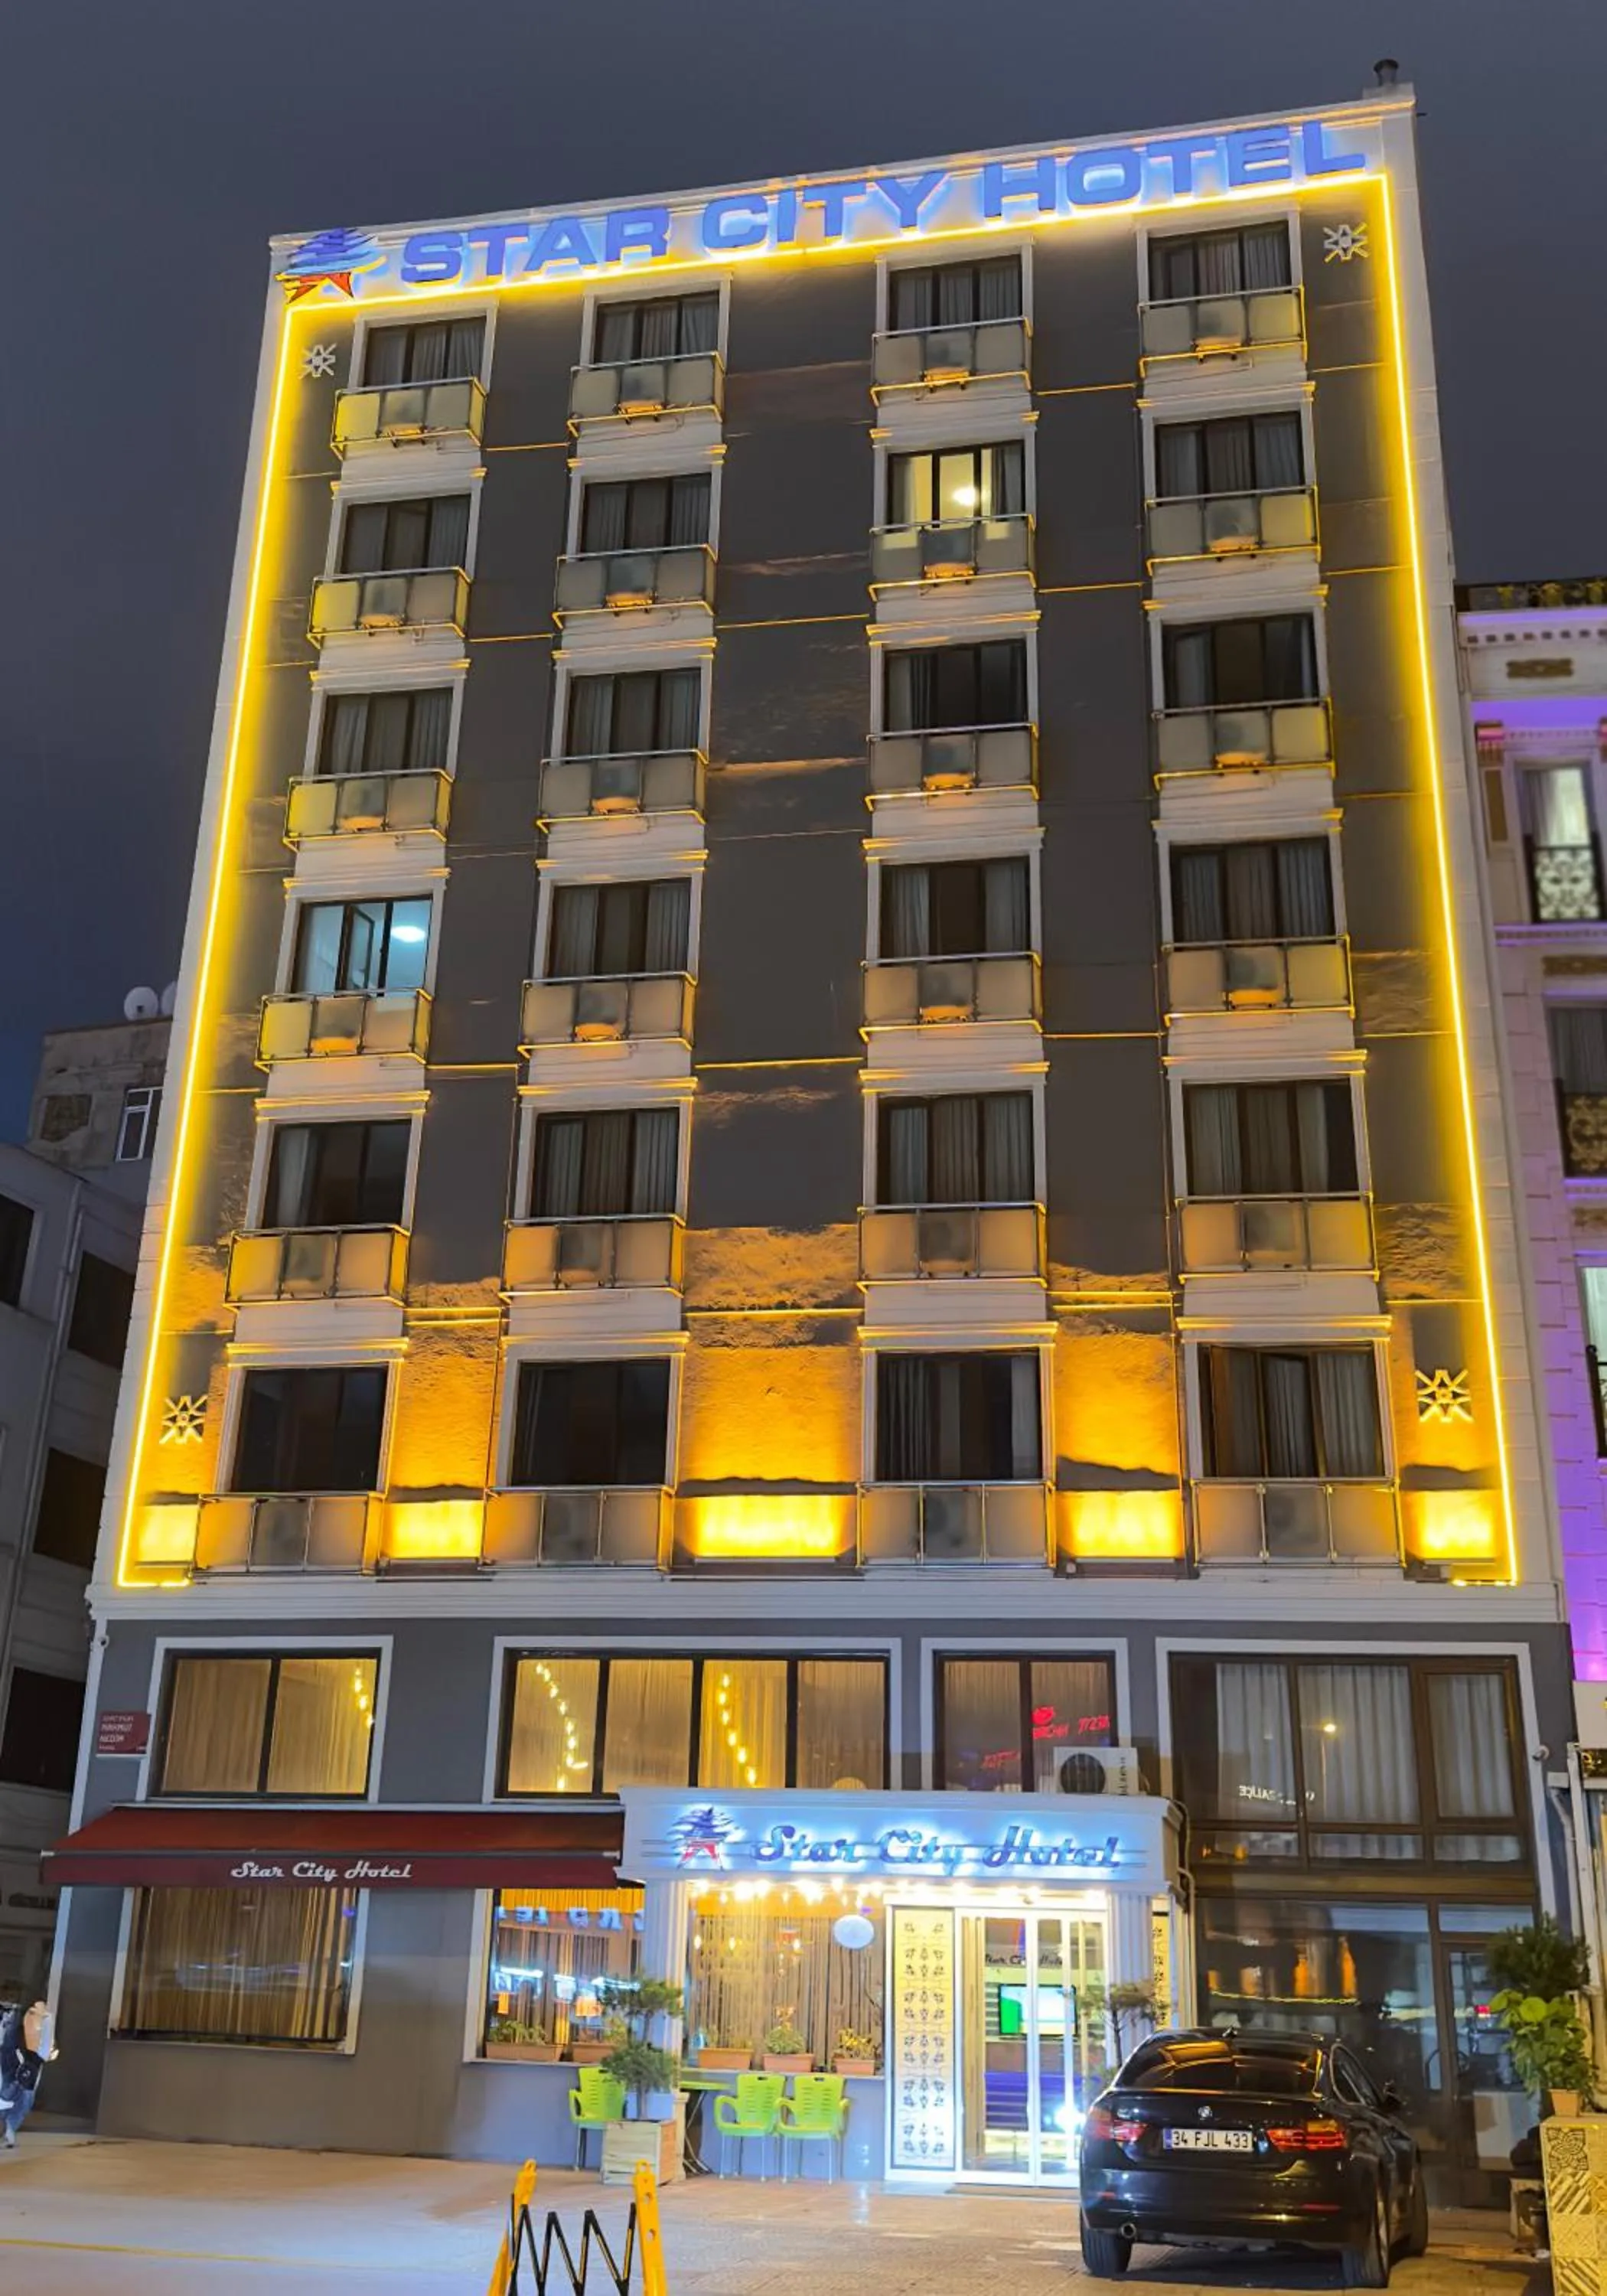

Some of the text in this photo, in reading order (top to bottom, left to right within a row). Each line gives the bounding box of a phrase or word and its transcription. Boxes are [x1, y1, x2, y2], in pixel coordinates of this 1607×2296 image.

[400, 120, 1366, 283] STAR CITY HOTEL
[750, 1825, 1120, 1877] Star City Hotel
[231, 1859, 412, 1882] Star City Hotel
[1172, 2130, 1249, 2149] 34 FJL 433
